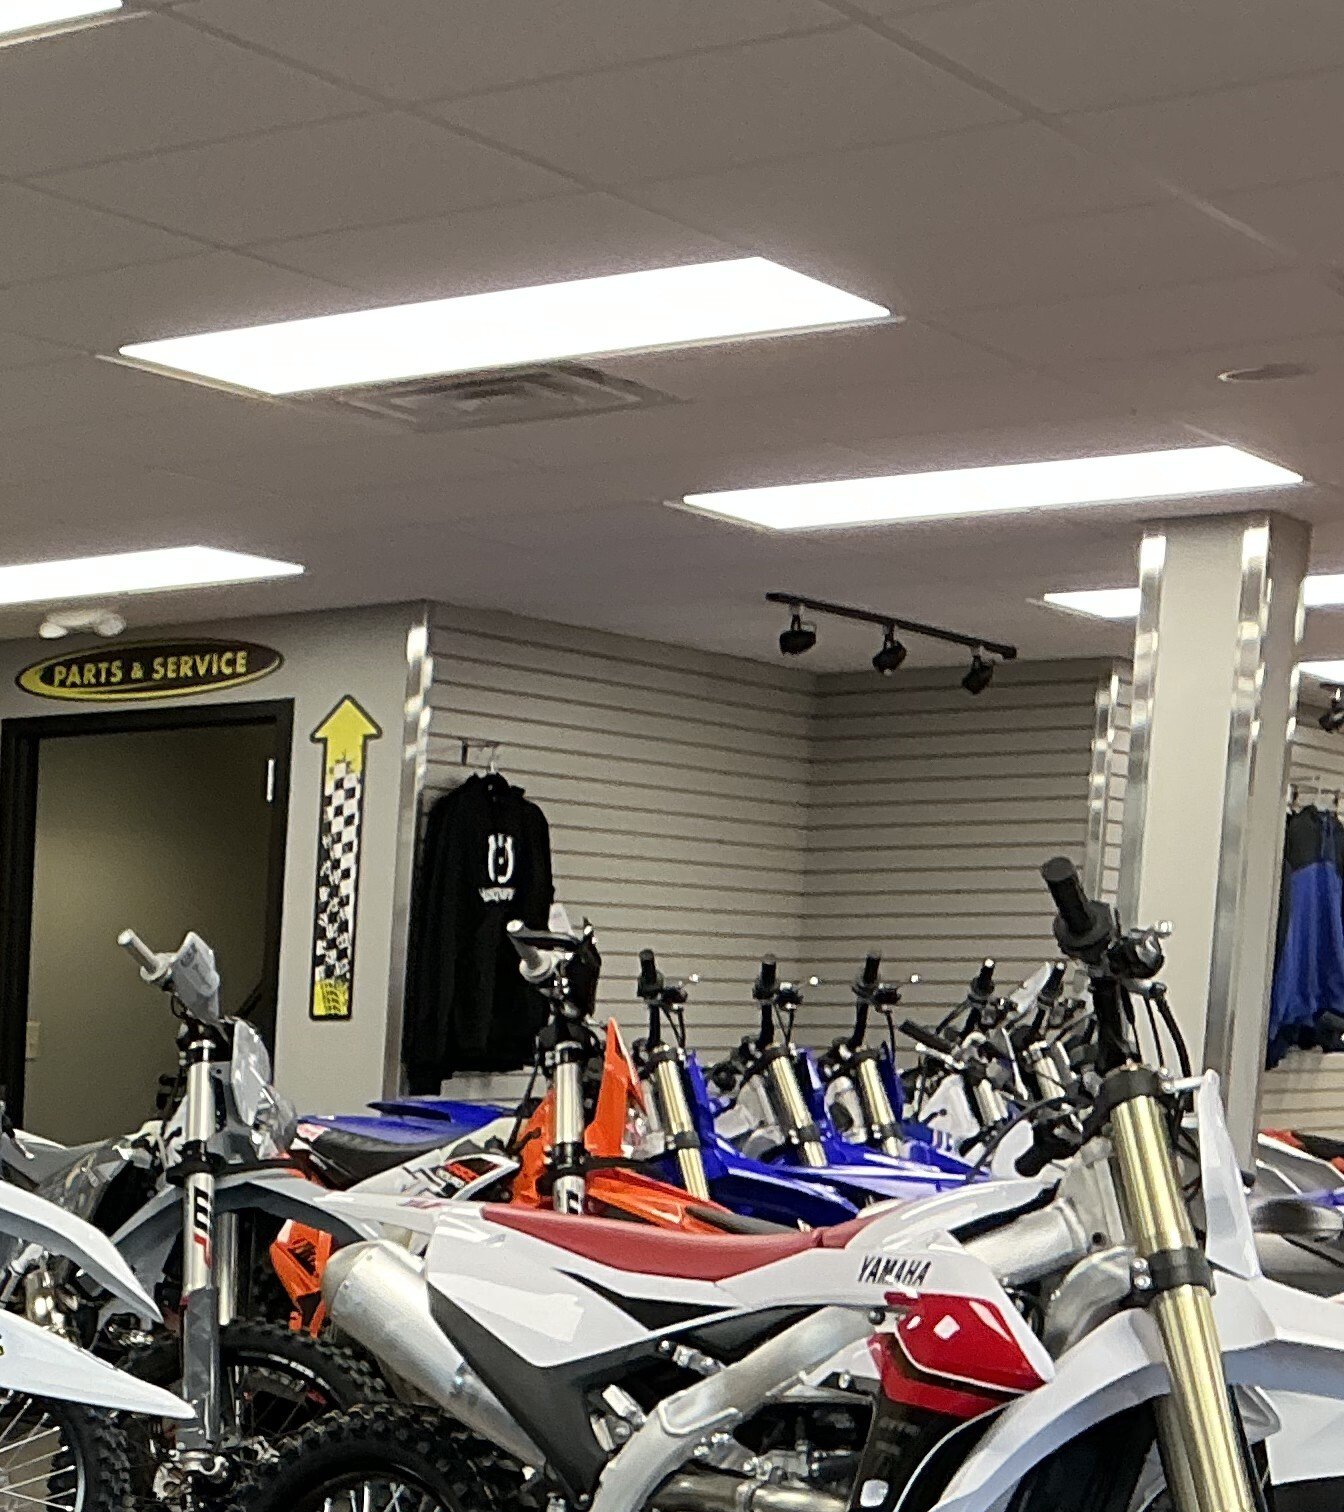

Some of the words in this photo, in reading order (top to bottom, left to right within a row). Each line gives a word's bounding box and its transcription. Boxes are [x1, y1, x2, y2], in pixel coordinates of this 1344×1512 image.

[53, 660, 123, 687] PARTS
[131, 661, 144, 680] &
[152, 650, 248, 681] SERVICE
[858, 1256, 932, 1286] YAMAHA
